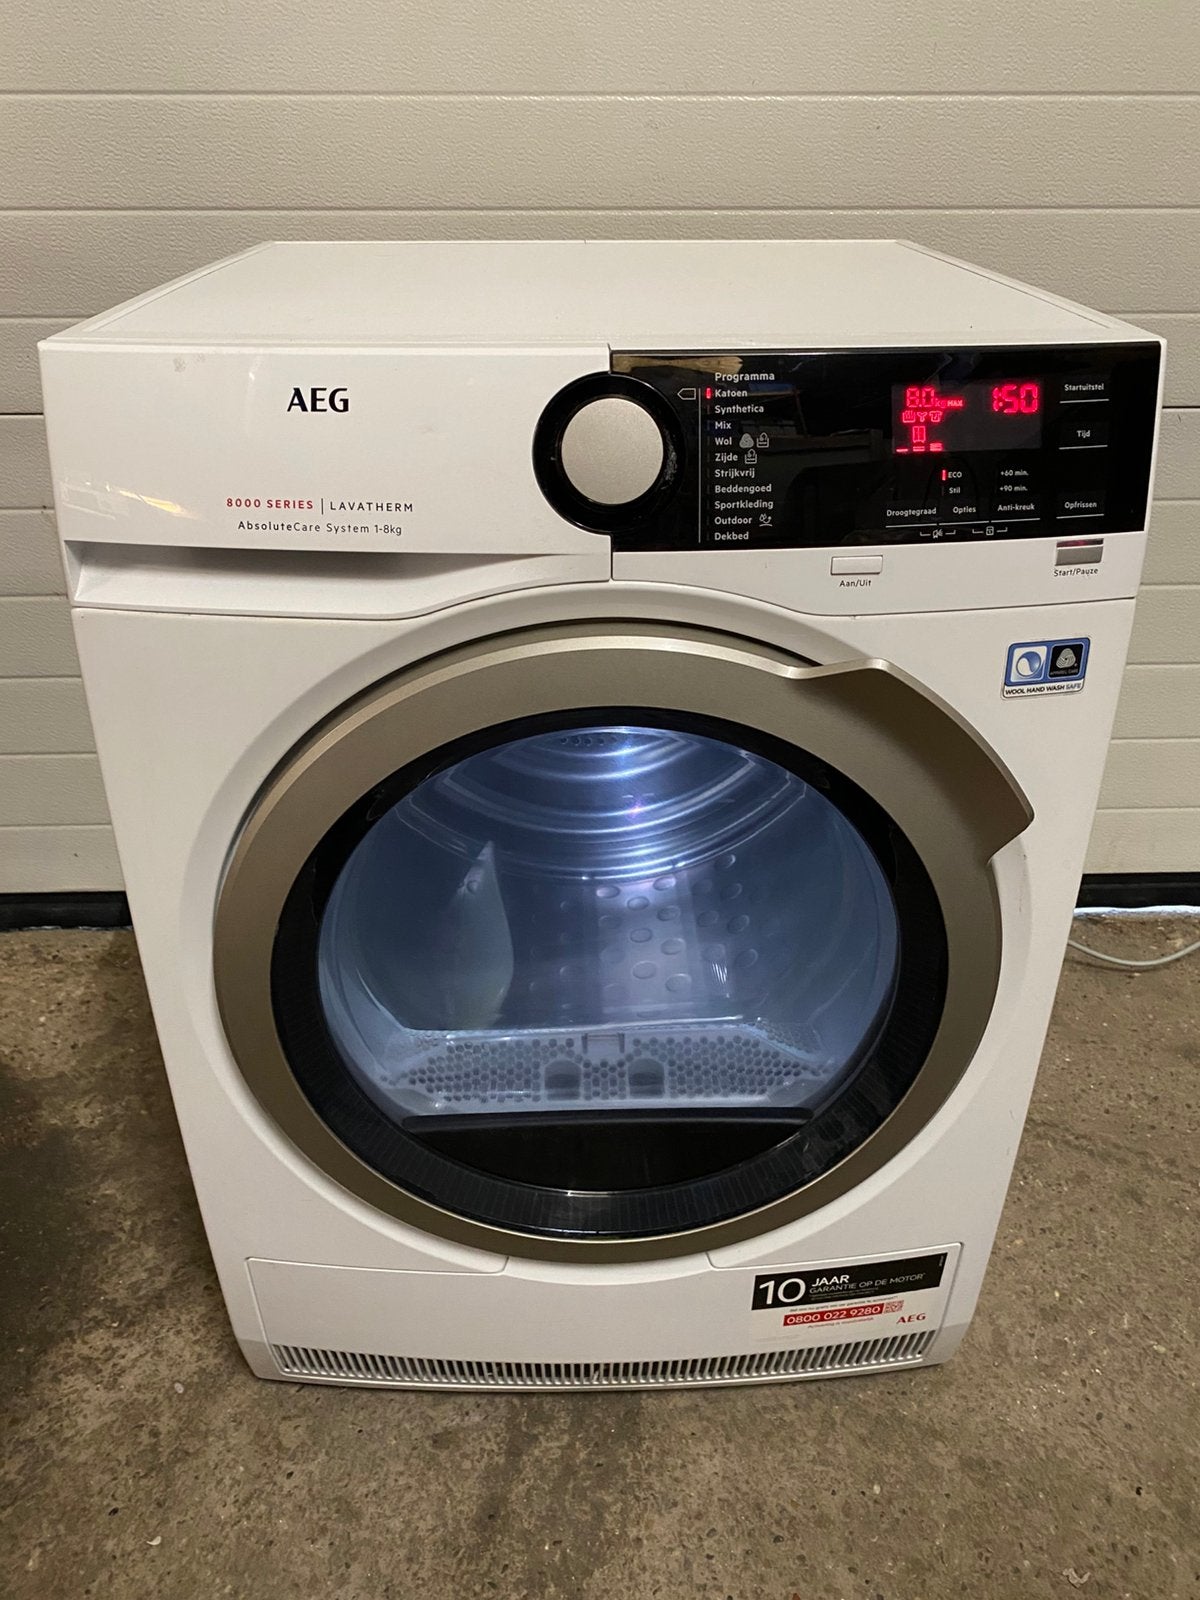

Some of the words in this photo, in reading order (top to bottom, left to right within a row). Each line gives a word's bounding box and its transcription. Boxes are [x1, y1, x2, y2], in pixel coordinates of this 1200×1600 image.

[714, 372, 776, 383] Programma
[1063, 382, 1105, 392] Startuitstel
[714, 389, 748, 398] Katoen
[287, 387, 350, 413] AEG
[714, 404, 765, 415] Synthetica
[714, 421, 732, 430] Mix
[1076, 429, 1091, 439] Tijd
[714, 437, 732, 446] Wol
[714, 452, 739, 463] Zijde
[714, 467, 755, 479] Strijkvrij
[948, 471, 963, 479] ECO
[1000, 469, 1014, 477] +60
[714, 483, 772, 495] Beddengoed
[948, 486, 961, 494] Stil
[999, 485, 1013, 493] +90
[226, 497, 262, 509] 8000
[266, 499, 314, 510] SERIES
[329, 501, 414, 513] LAVATHERM
[714, 499, 774, 511] Sportkleding
[952, 505, 977, 515] Opties
[997, 502, 1036, 513] Anti-kreuk
[1064, 501, 1098, 510] Opfrissen
[886, 507, 938, 518] Droogtegraad
[714, 515, 753, 525] Outdoor
[237, 520, 321, 532] AbsoluteCare
[326, 522, 370, 535] System
[374, 524, 402, 537] 1-8kg
[714, 531, 750, 541] Dekbed
[1053, 567, 1099, 578] Start/Pauze
[839, 579, 872, 588] Aan/Uit
[1065, 682, 1082, 690] SAFE
[809, 1282, 857, 1294] GARANTIE
[858, 1280, 874, 1289] OP
[874, 1278, 889, 1287] DE
[811, 1274, 850, 1287] JAAR
[759, 1277, 807, 1306] 10
[786, 1313, 821, 1325] 0800
[823, 1309, 848, 1321] 022
[849, 1305, 881, 1317] 9280
[896, 1312, 927, 1325] AEG
